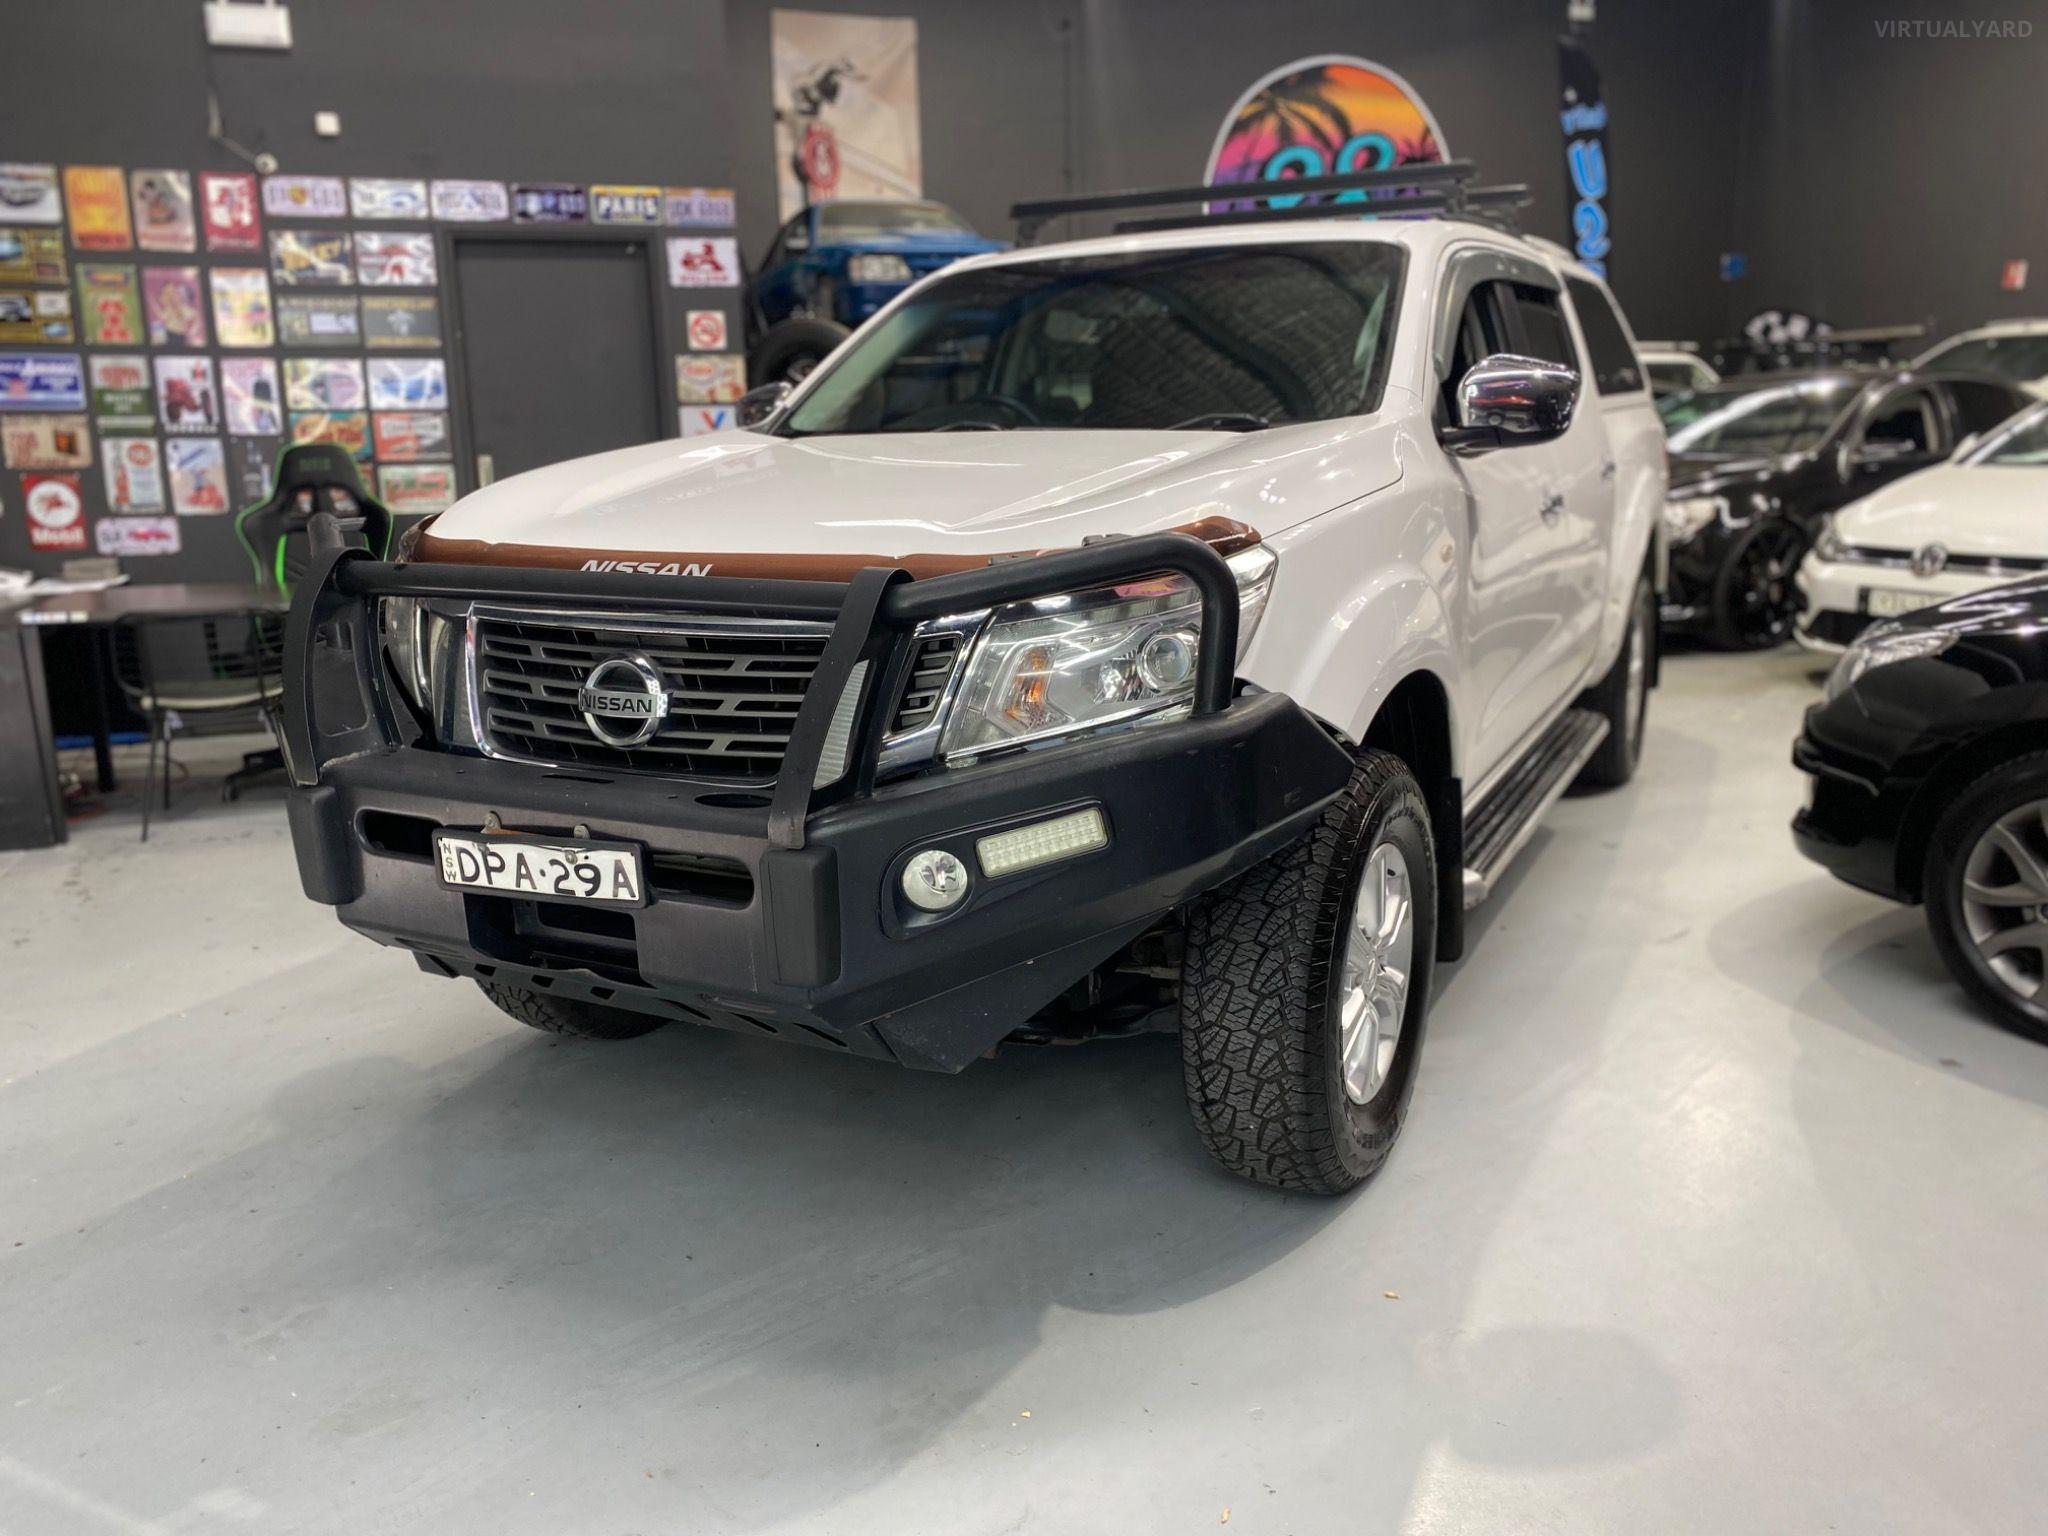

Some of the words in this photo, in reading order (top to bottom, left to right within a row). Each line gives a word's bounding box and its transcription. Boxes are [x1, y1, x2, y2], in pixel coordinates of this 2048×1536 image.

[597, 196, 658, 216] PARIS
[580, 559, 713, 577] NISSAN
[580, 692, 652, 713] NISSAN
[442, 842, 457, 882] NSW
